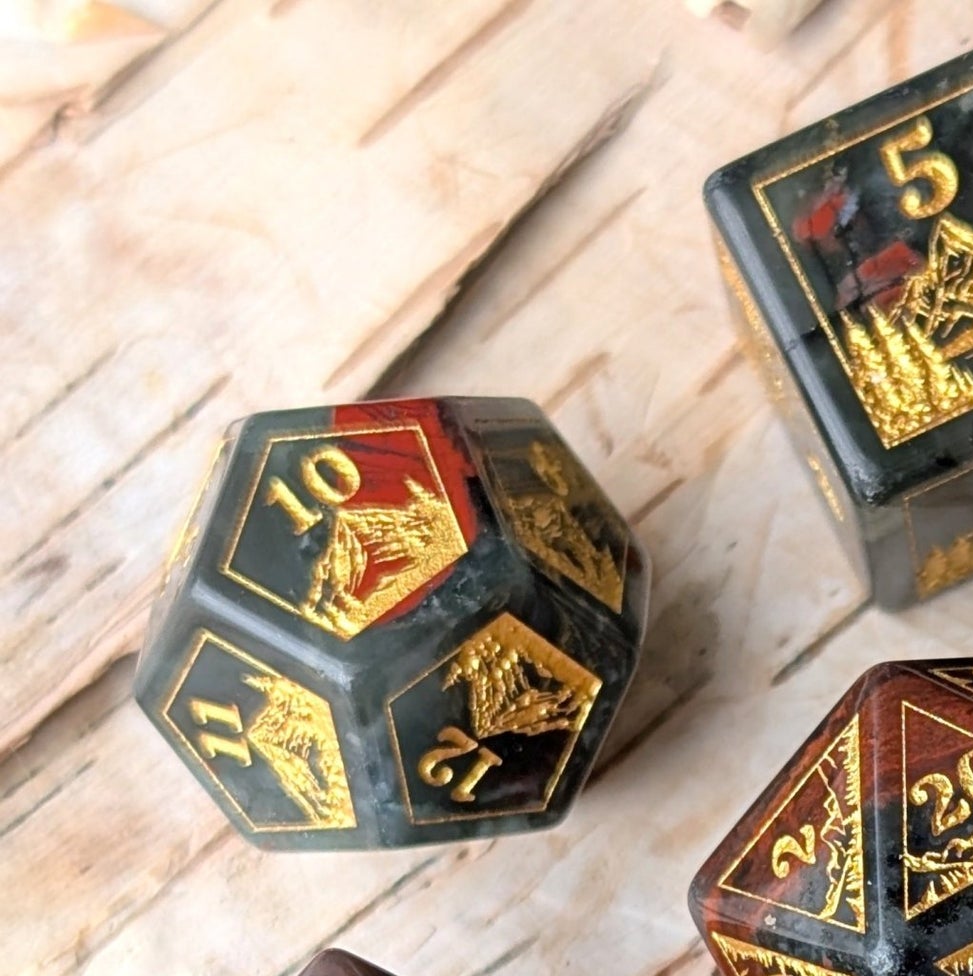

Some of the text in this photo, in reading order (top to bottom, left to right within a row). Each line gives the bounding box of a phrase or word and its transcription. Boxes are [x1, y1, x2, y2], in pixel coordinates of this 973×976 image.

[880, 115, 959, 219] 5
[265, 445, 361, 536] 10
[190, 698, 252, 768] 11
[418, 725, 503, 803] 12
[771, 822, 817, 880] 2
